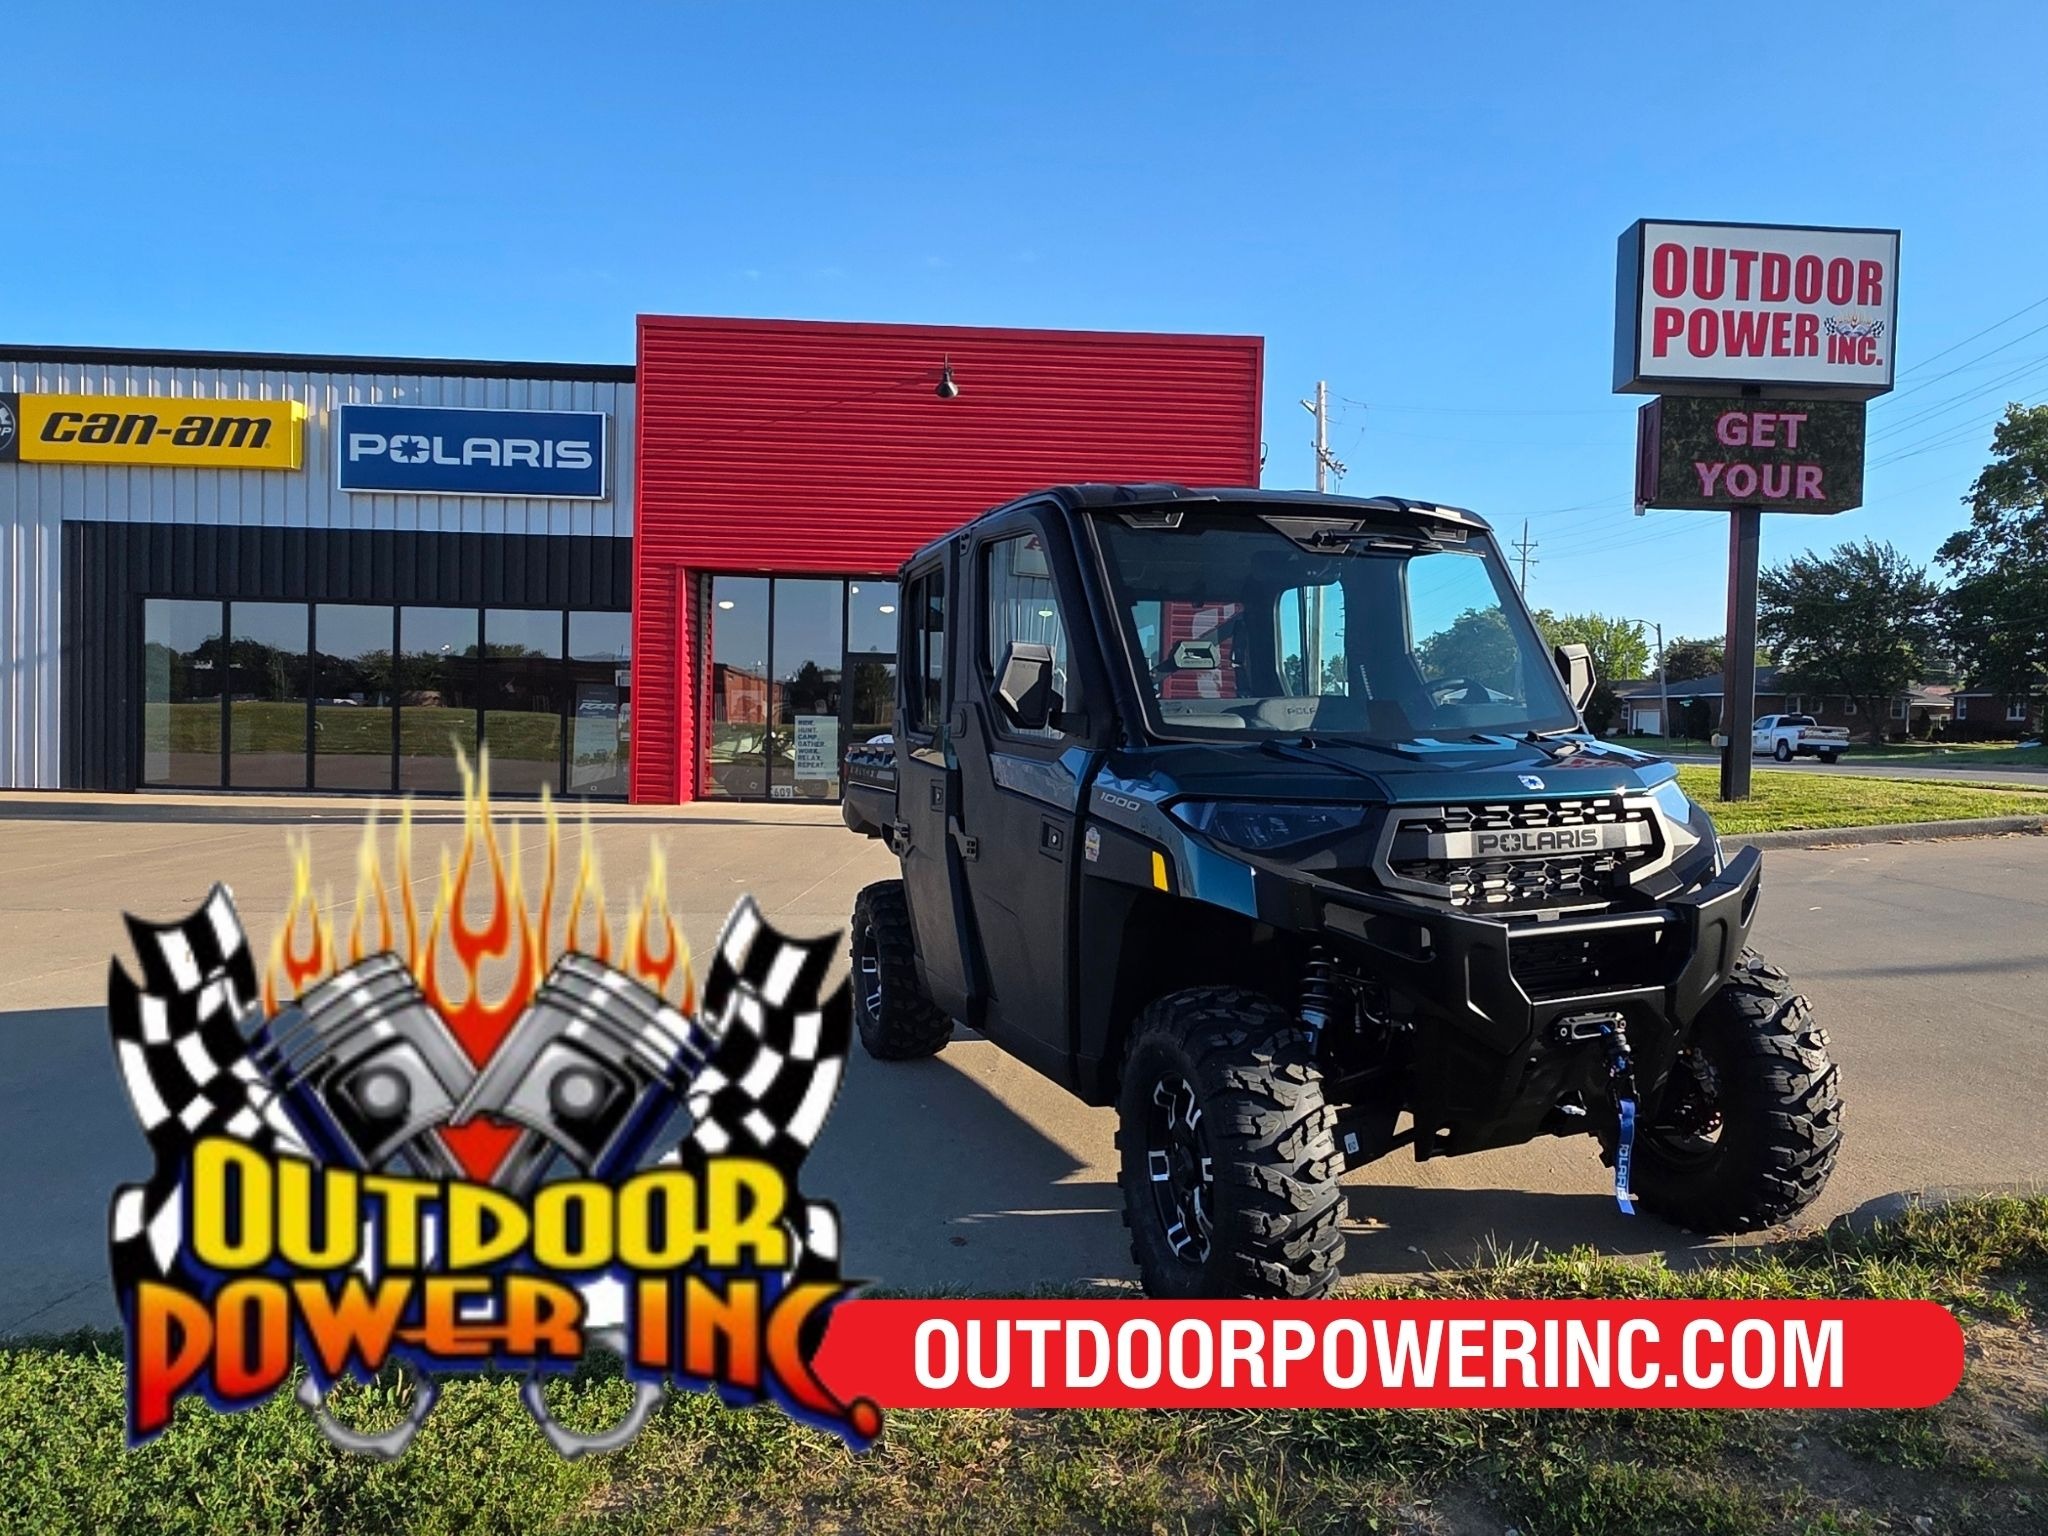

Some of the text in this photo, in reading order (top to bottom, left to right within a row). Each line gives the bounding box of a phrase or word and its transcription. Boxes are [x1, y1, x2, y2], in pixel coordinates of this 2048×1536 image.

[1652, 243, 1884, 306] OUTDOOR
[1652, 306, 1883, 366] POWER INC.
[40, 411, 272, 450] can-am
[1715, 411, 1807, 449] GET
[348, 433, 593, 470] POLARIS
[1694, 462, 1826, 500] YOUR
[1100, 791, 1140, 812] 1000
[1477, 828, 1598, 854] POLARIS
[1617, 1143, 1630, 1201] POLARIS
